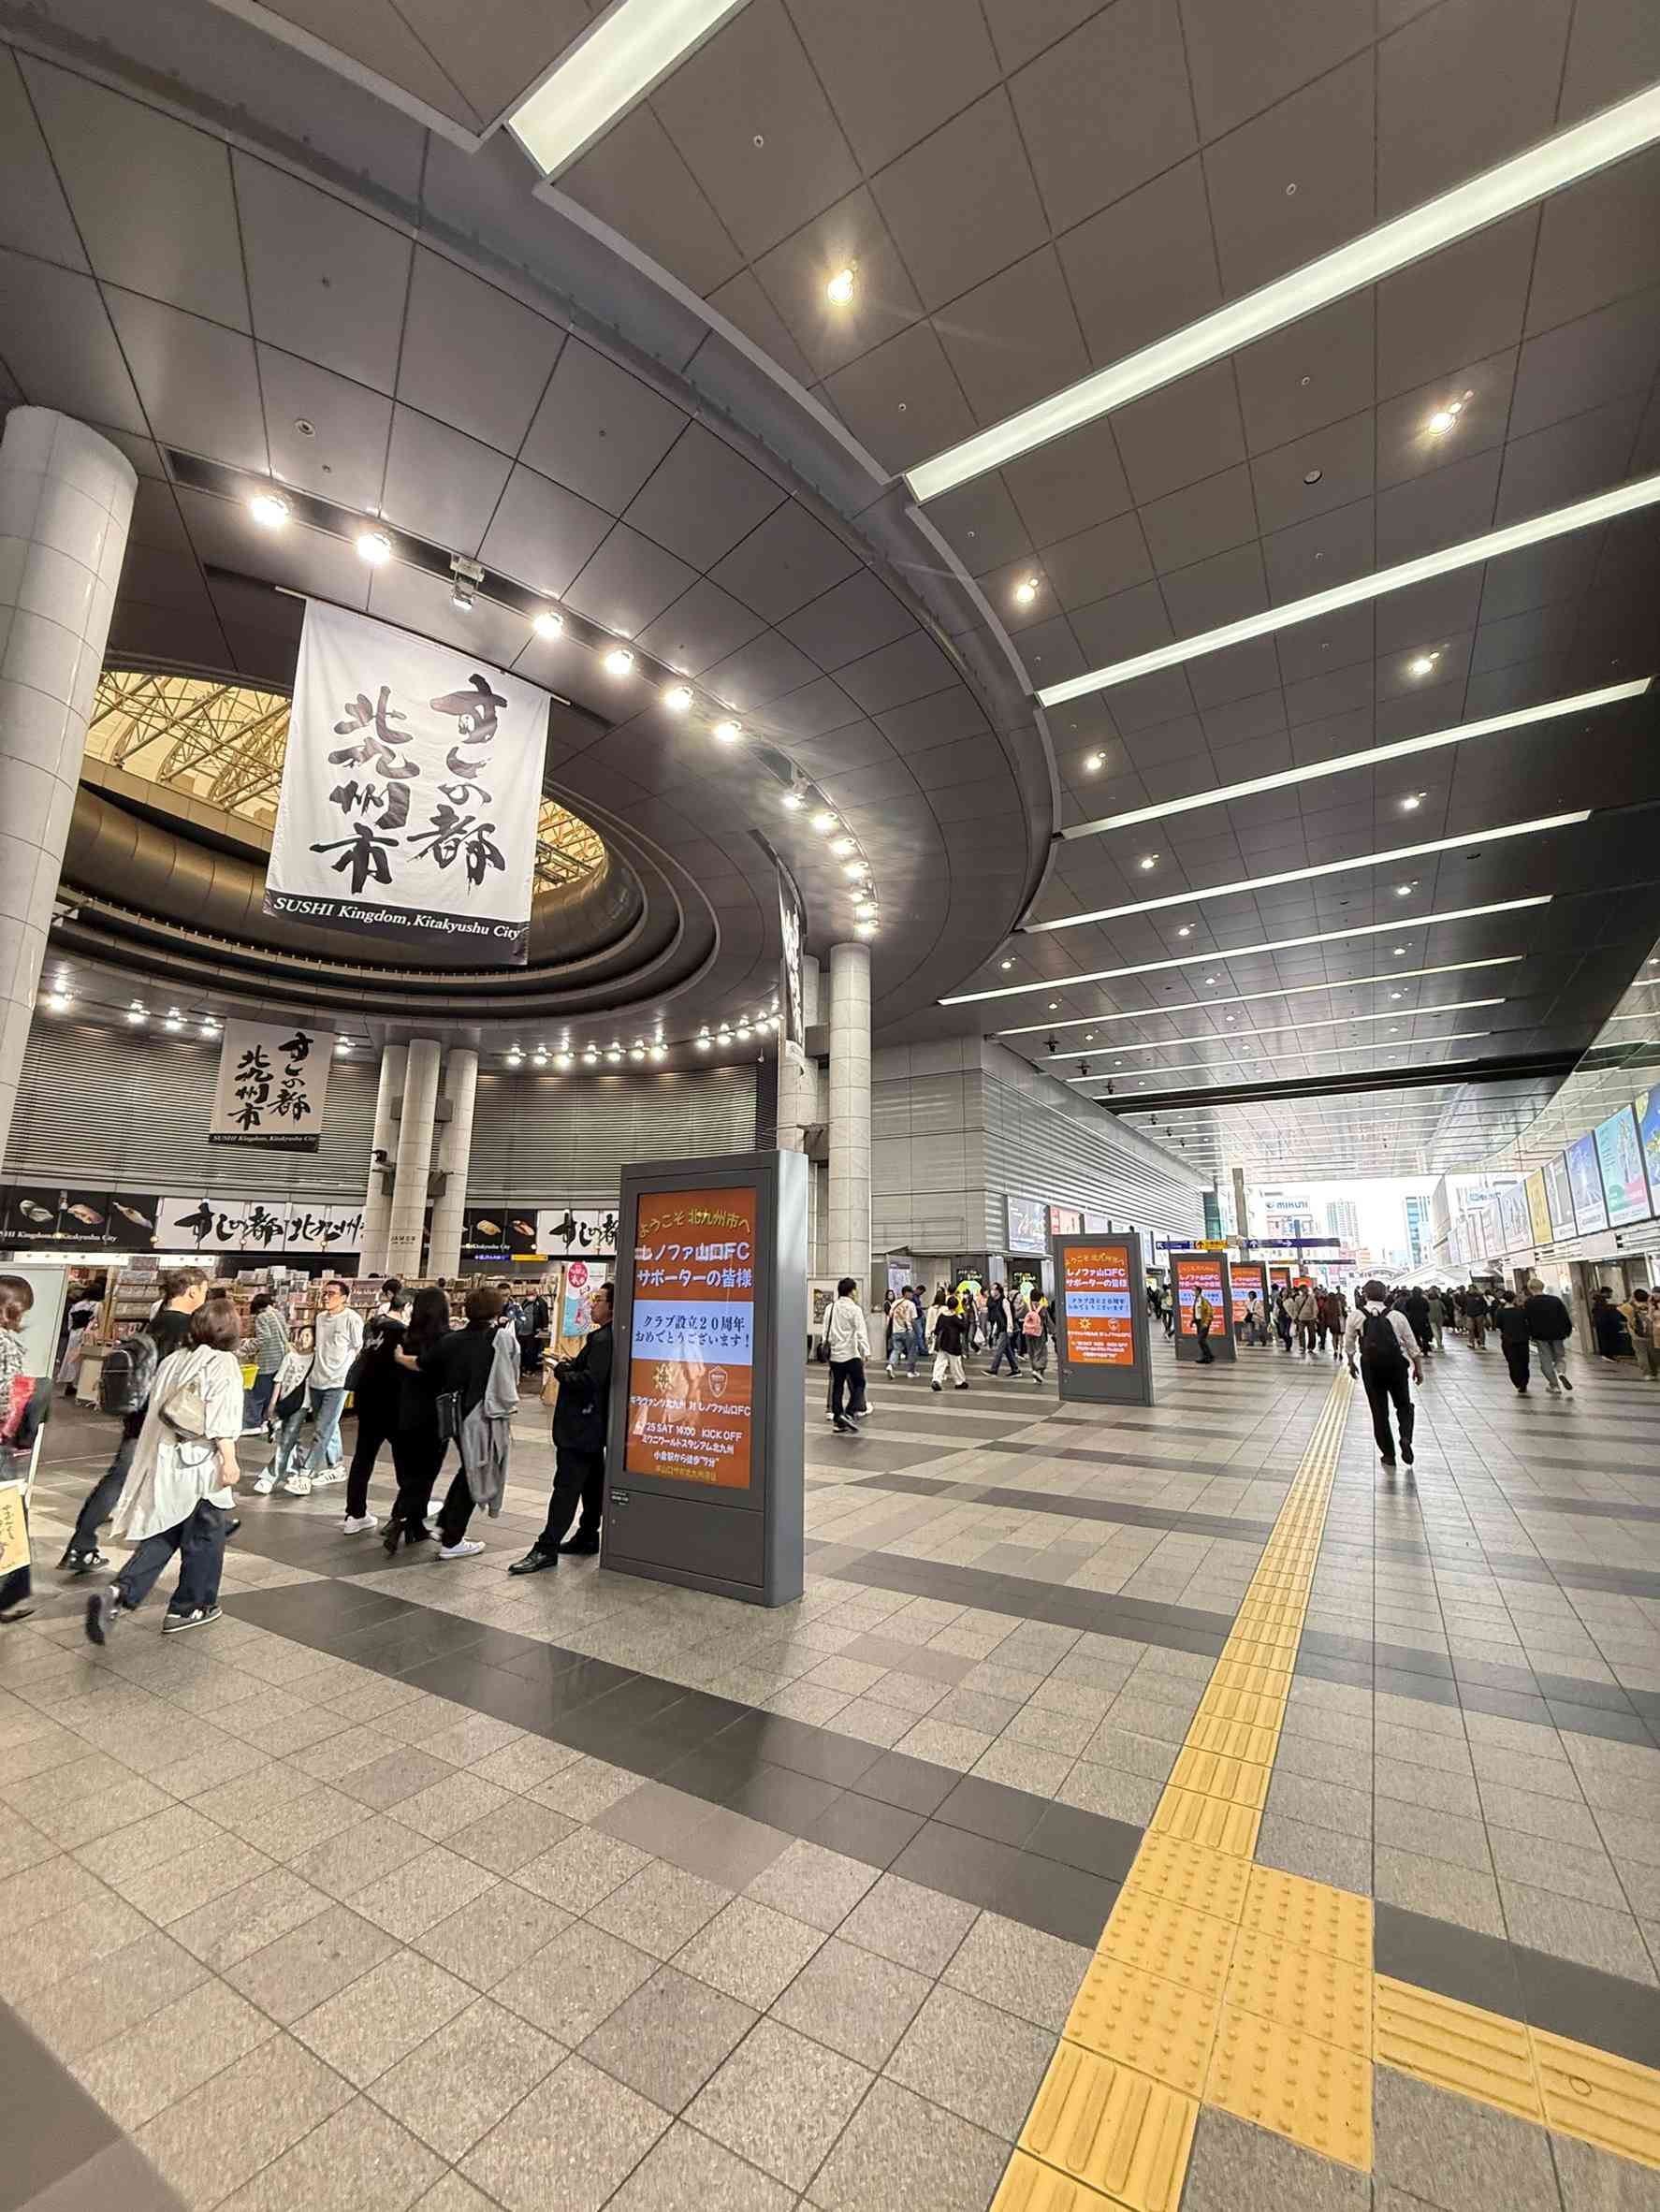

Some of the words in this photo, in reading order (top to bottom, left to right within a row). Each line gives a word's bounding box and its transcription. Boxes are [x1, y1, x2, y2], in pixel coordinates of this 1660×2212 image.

[310, 685, 421, 894] 北九州市
[407, 673, 507, 895] すしの都
[273, 896, 335, 916] SUSHI
[338, 905, 412, 926] Kingdom,
[414, 914, 490, 935] Kitakyushu
[492, 924, 522, 940] City
[227, 1044, 274, 1131] 北九州市
[267, 1031, 314, 1123] すしの都
[639, 1211, 686, 1238] ようこそ
[688, 1208, 751, 1233] 北九州市へ
[637, 1268, 753, 1288] サポーターの皆様
[657, 1422, 674, 1433] SAT
[702, 1428, 723, 1440] KICK
[723, 1431, 744, 1442] OFF
